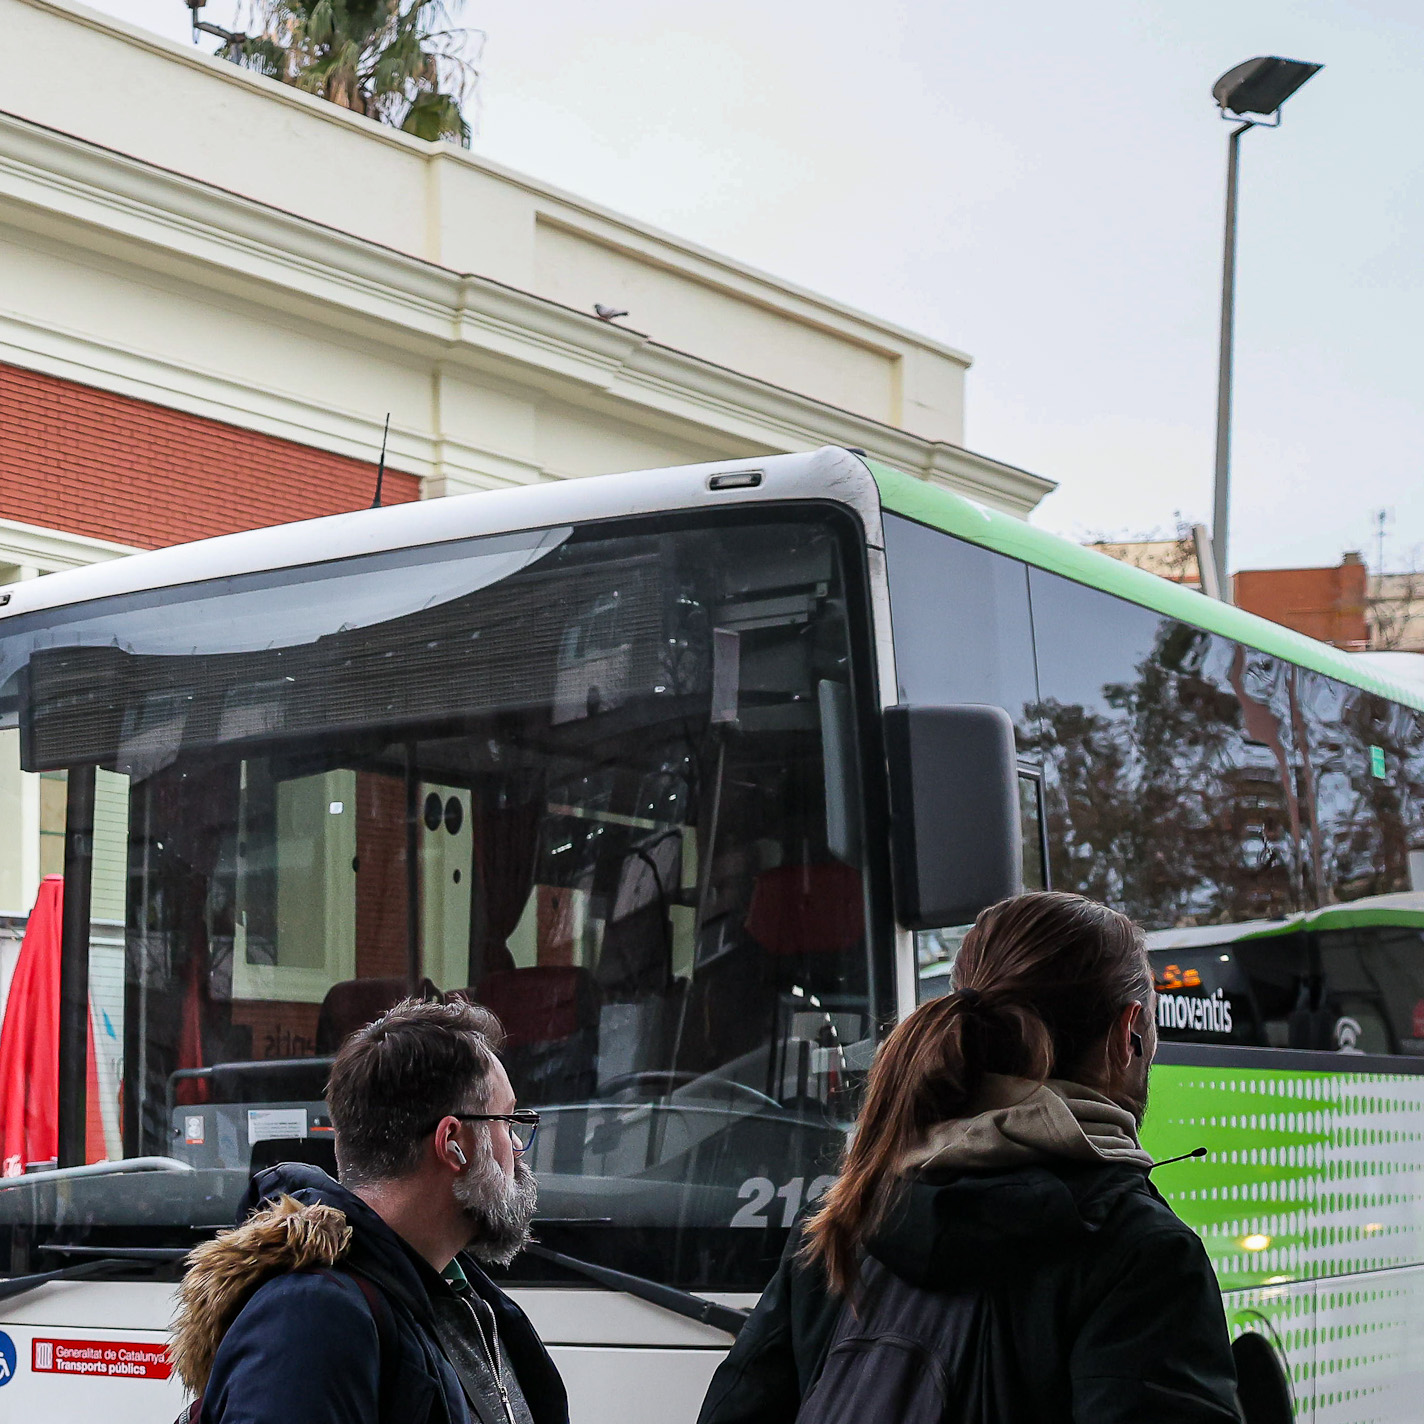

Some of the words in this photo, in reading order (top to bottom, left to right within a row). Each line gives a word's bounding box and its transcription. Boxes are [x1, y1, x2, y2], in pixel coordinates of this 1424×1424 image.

[55, 1345, 103, 1360] Generalitat
[104, 1349, 117, 1361] de
[118, 1349, 166, 1366] Catalunya
[55, 1358, 107, 1374] Transports
[109, 1361, 147, 1376] públics
